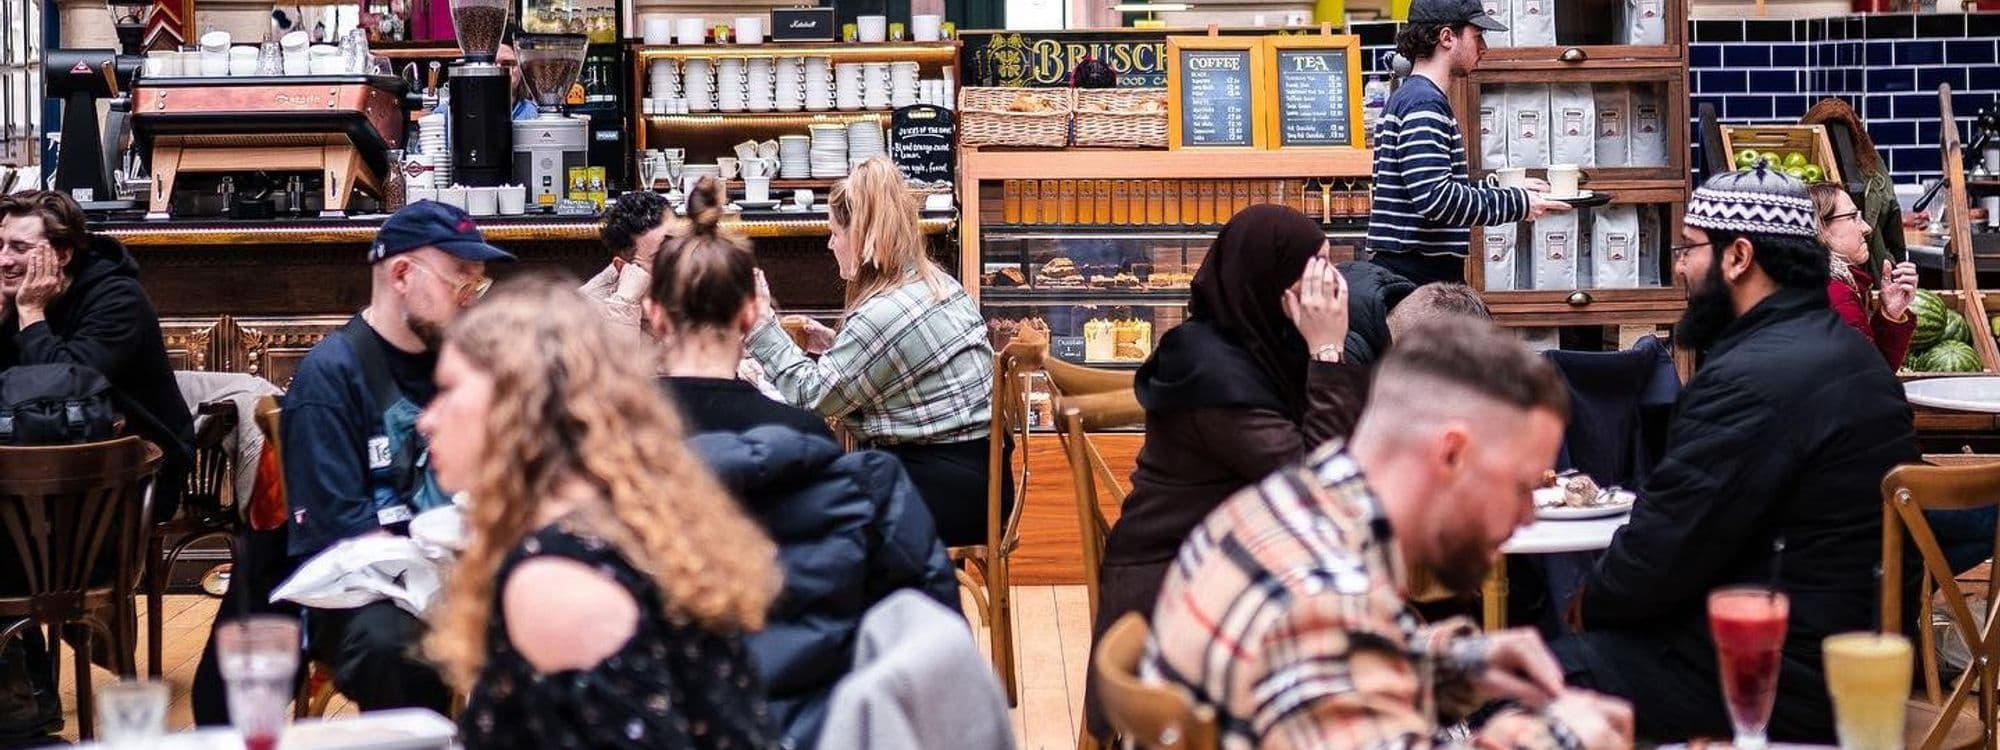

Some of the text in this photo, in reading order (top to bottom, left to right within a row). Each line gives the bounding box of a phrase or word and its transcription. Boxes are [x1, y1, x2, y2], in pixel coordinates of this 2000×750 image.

[1190, 57, 1240, 70] COFFEE
[1292, 56, 1330, 71] TEA
[1116, 77, 1147, 86] FOOD
